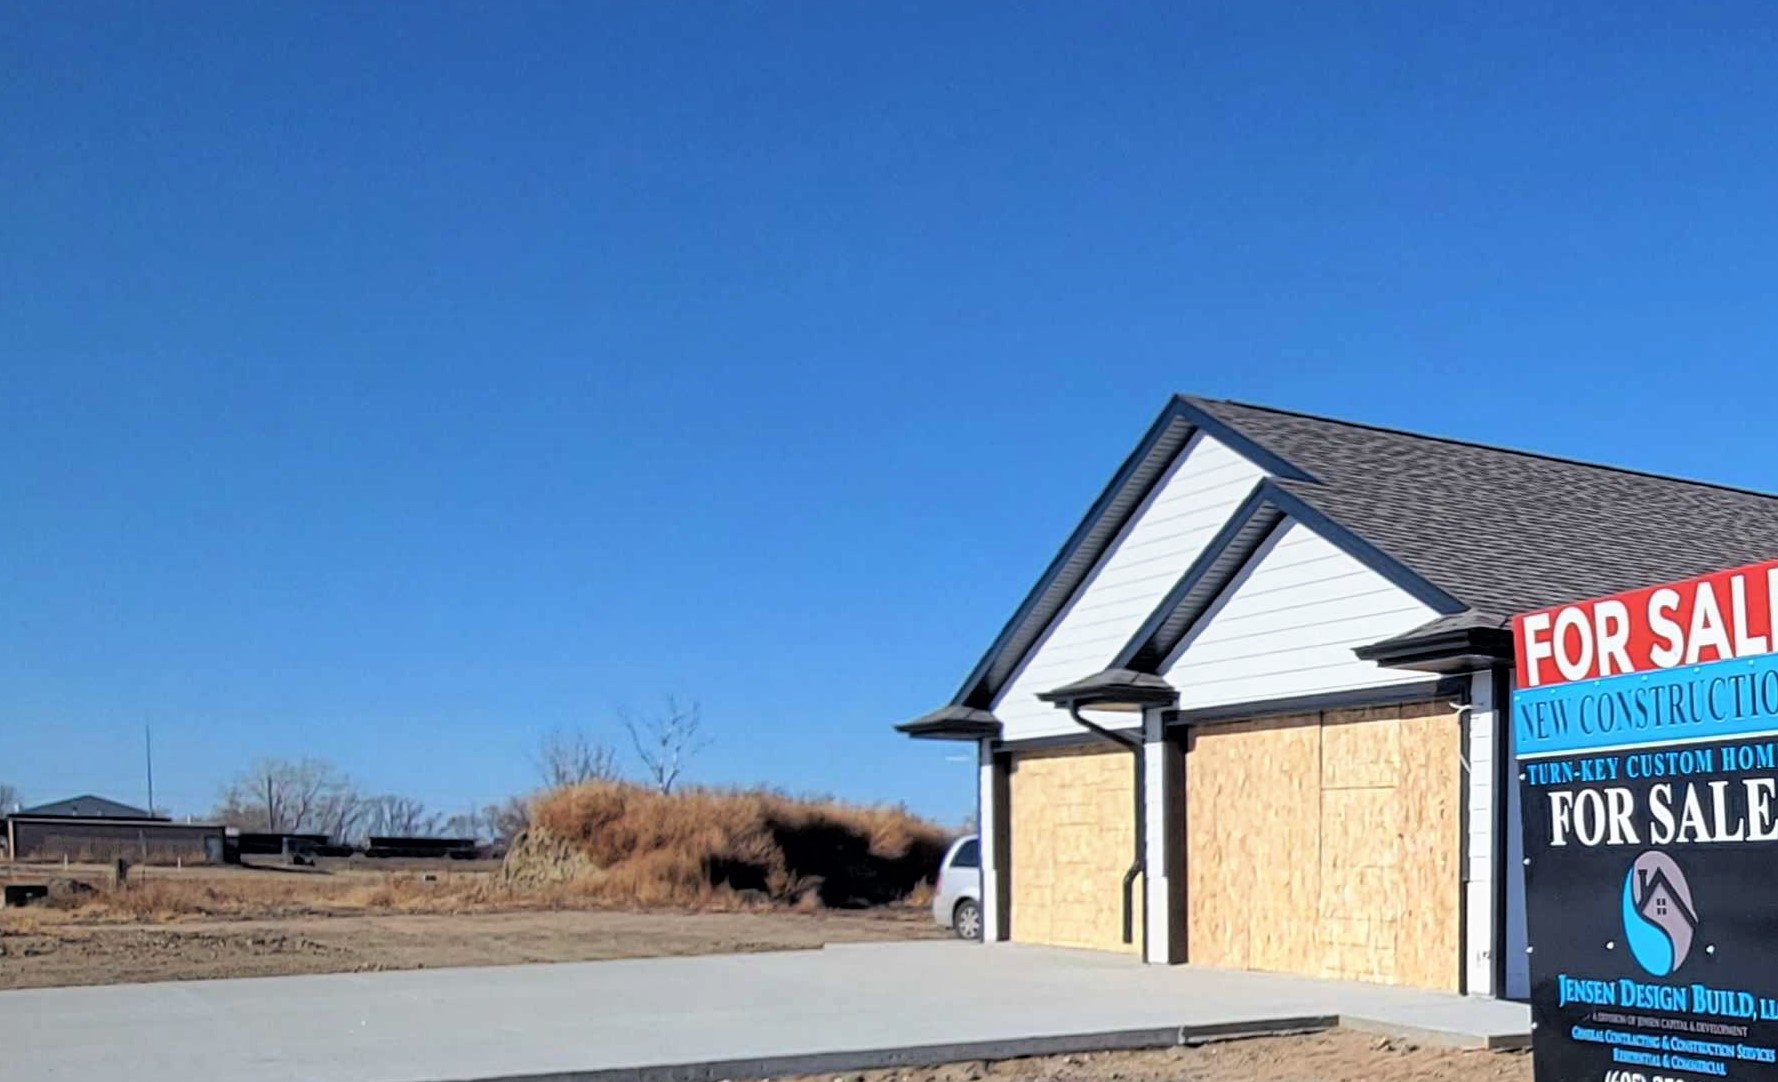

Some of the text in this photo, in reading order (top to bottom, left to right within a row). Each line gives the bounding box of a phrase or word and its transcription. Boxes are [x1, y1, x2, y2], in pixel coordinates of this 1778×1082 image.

[1522, 599, 1635, 686] FOR
[1521, 699, 1569, 741] NEW
[1526, 757, 1619, 785] TURN-KEY
[1626, 750, 1712, 778] CUSTOM
[1548, 788, 1639, 846] FOR
[1558, 974, 1616, 1008] JENSEN
[1619, 979, 1688, 1014] DESIGN
[1691, 984, 1757, 1021] BUILD,
[1662, 1035, 1670, 1050] &
[1663, 1054, 1670, 1068] &
